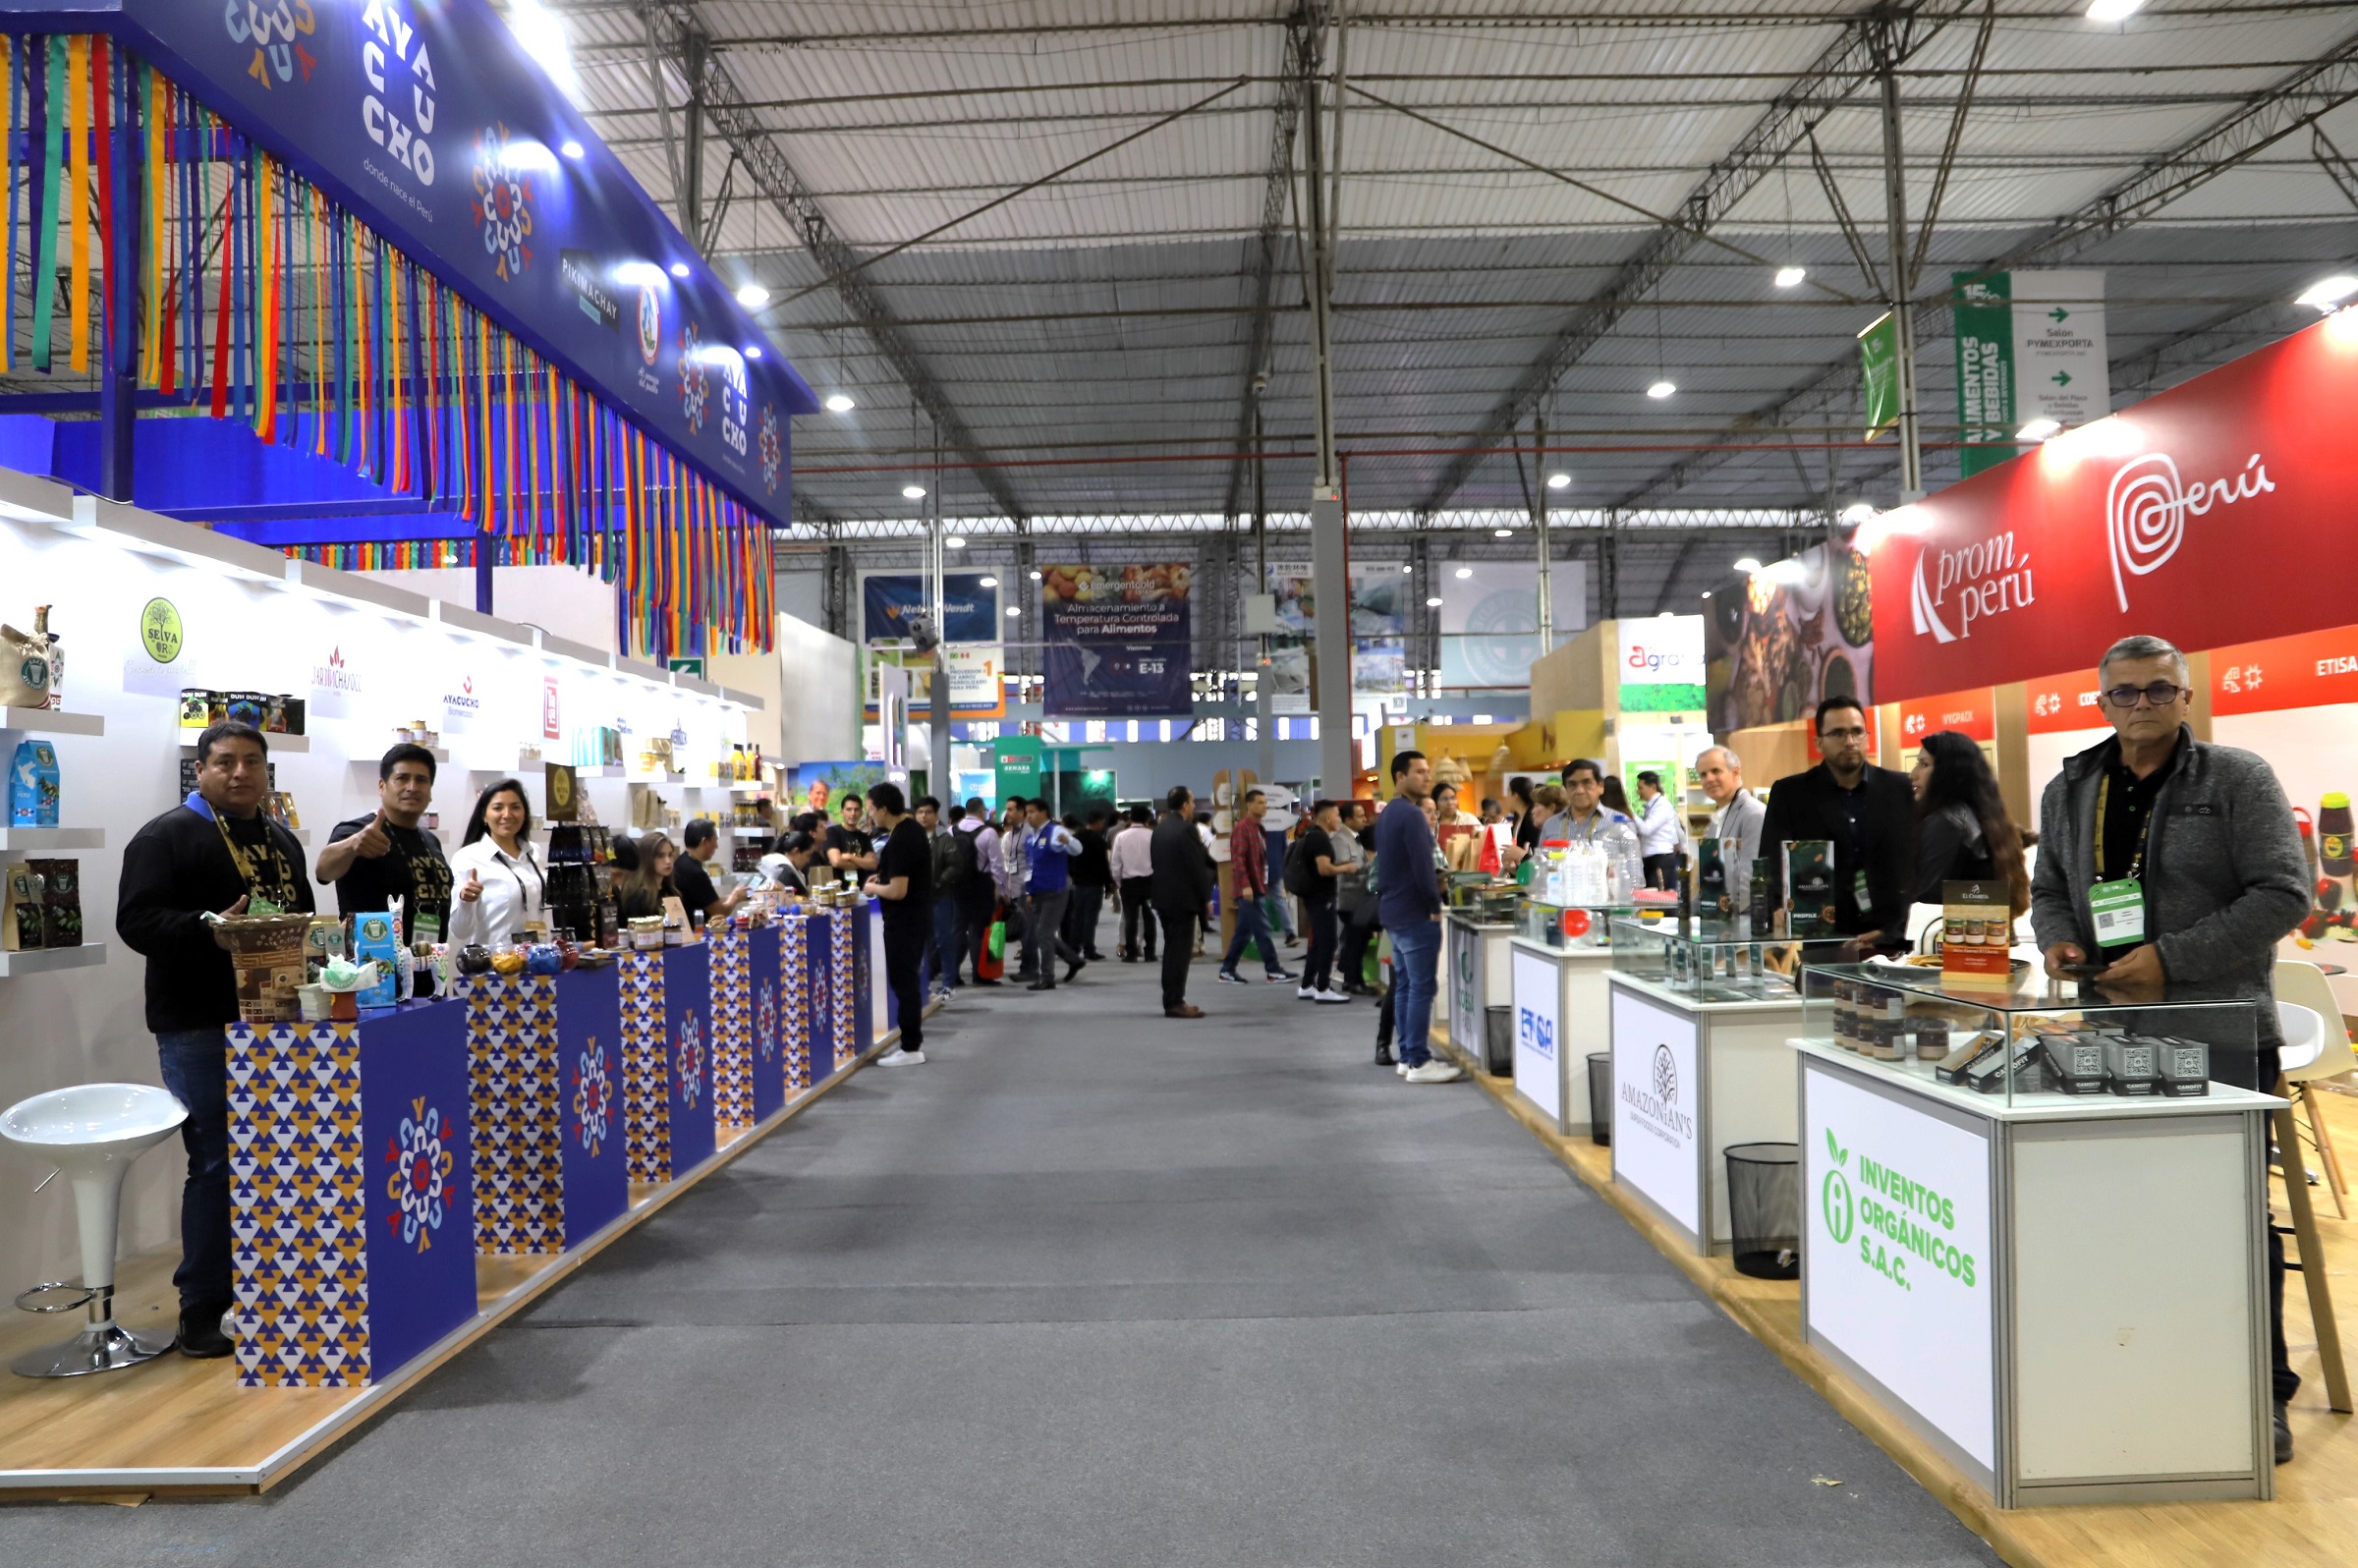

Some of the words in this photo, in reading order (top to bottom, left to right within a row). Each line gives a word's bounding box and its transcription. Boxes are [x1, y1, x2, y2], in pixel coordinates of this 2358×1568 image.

[364, 157, 389, 187] donde
[390, 180, 408, 202] nace
[409, 196, 416, 208] el
[417, 199, 433, 223] Perú
[562, 257, 618, 320] PIKIMACHAY
[2027, 339, 2094, 349] PYMEXPORTA
[2047, 328, 2073, 337] Salón
[1962, 336, 1984, 443] ALIMENTOS
[1981, 342, 2002, 423] BEBIDAS
[1985, 428, 2002, 441] Y
[2106, 452, 2275, 614] Perú
[1935, 531, 2015, 607] prom
[1091, 580, 1155, 591] emergentcold
[1959, 552, 2036, 640] perú
[1054, 614, 1120, 625] Temperatura
[1122, 612, 1179, 622] Controlada
[1067, 603, 1157, 613] Almacenamiento
[1077, 626, 1099, 635] para
[1101, 624, 1157, 634] Alimentos
[1139, 662, 1165, 674] E-13
[2317, 655, 2358, 677] ETISA
[1942, 710, 1974, 725] VYGPACK
[1967, 1047, 1995, 1071] CAMOFIT
[1994, 1055, 2029, 1079] CAOFIT
[1860, 1154, 1955, 1231] INVENTOS
[1860, 1196, 1976, 1288] ORGÁNICOS
[1860, 1235, 1912, 1292] S.A.C.
